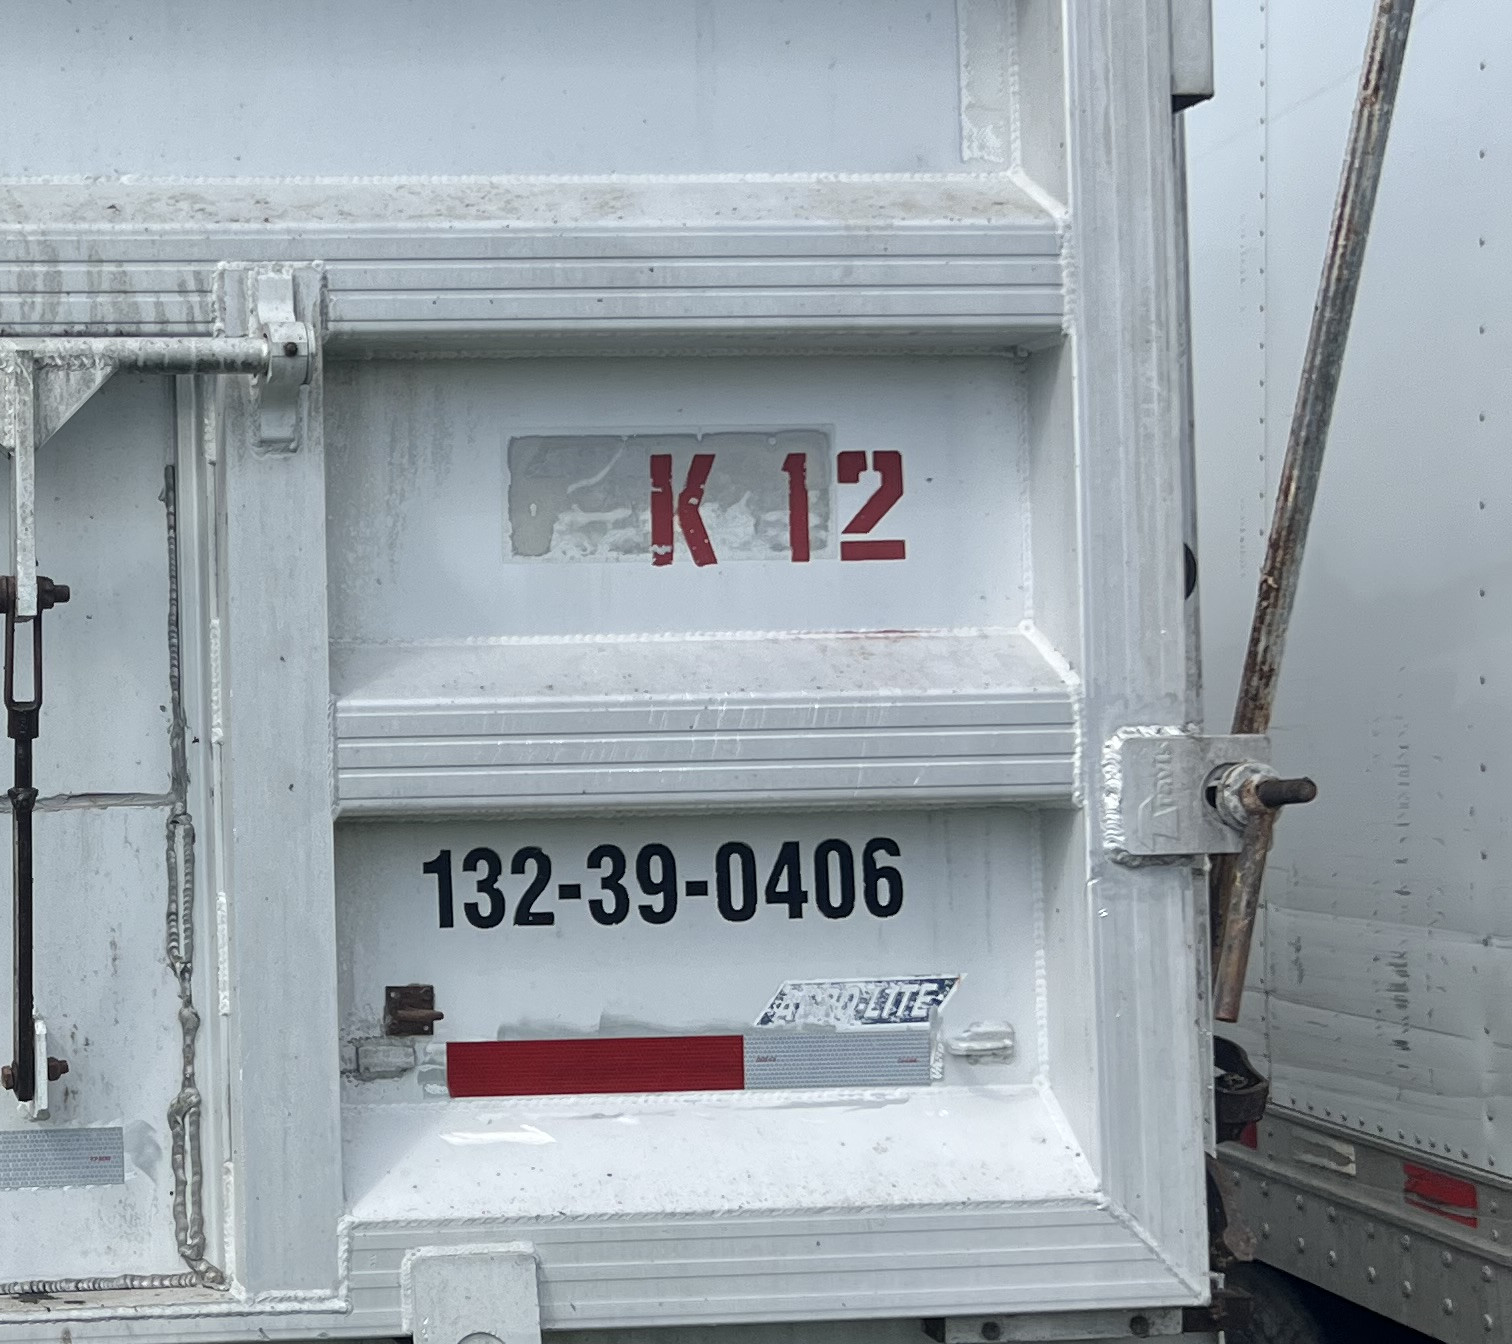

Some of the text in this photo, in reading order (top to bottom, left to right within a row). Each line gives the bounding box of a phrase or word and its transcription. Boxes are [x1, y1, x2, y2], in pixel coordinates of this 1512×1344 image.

[650, 450, 906, 567] K 12
[422, 837, 904, 929] 132-39-0406
